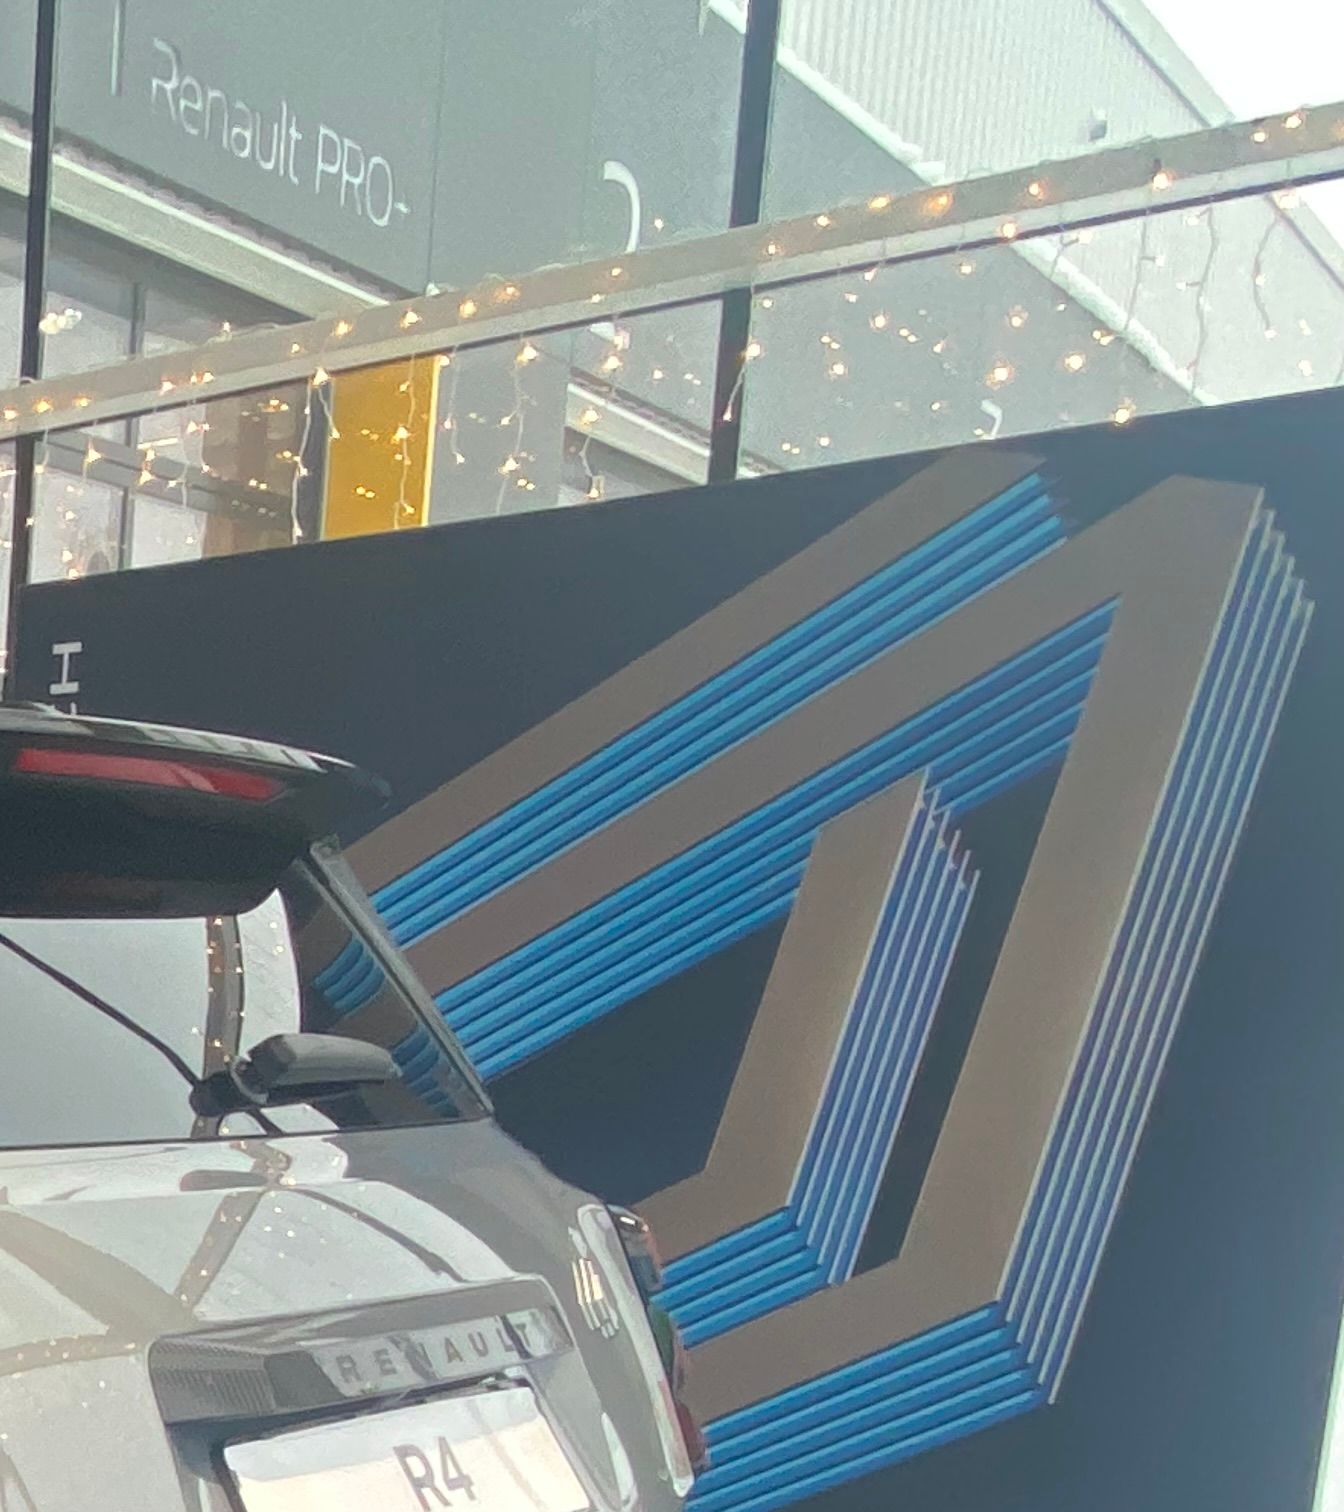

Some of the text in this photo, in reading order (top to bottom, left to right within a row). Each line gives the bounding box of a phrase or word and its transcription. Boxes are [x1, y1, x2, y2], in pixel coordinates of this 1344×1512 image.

[150, 37, 303, 186] Renault
[334, 1321, 532, 1384] RENAULT
[392, 1435, 477, 1512] R4
